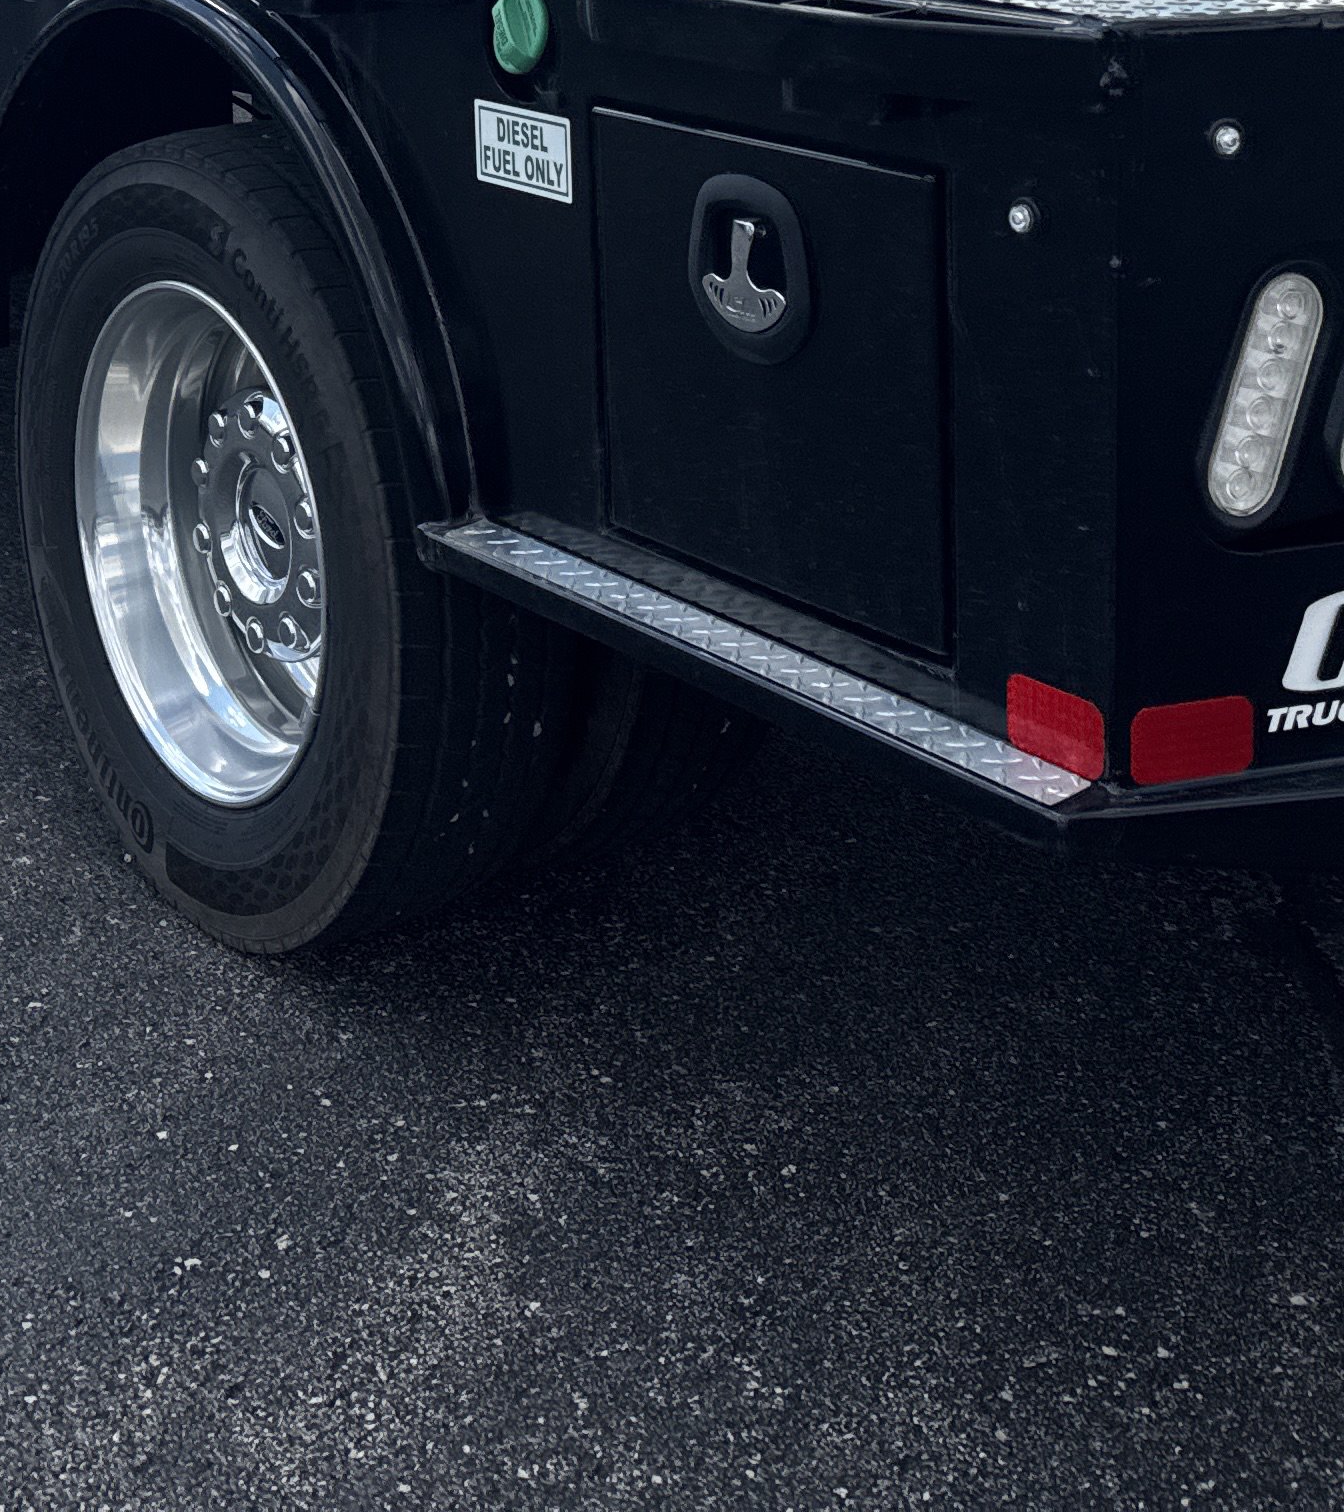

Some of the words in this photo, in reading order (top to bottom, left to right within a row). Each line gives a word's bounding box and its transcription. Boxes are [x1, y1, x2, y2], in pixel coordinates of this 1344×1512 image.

[496, 116, 548, 153] DIESEL
[483, 145, 520, 177] FUEL
[524, 154, 564, 188] ONLY
